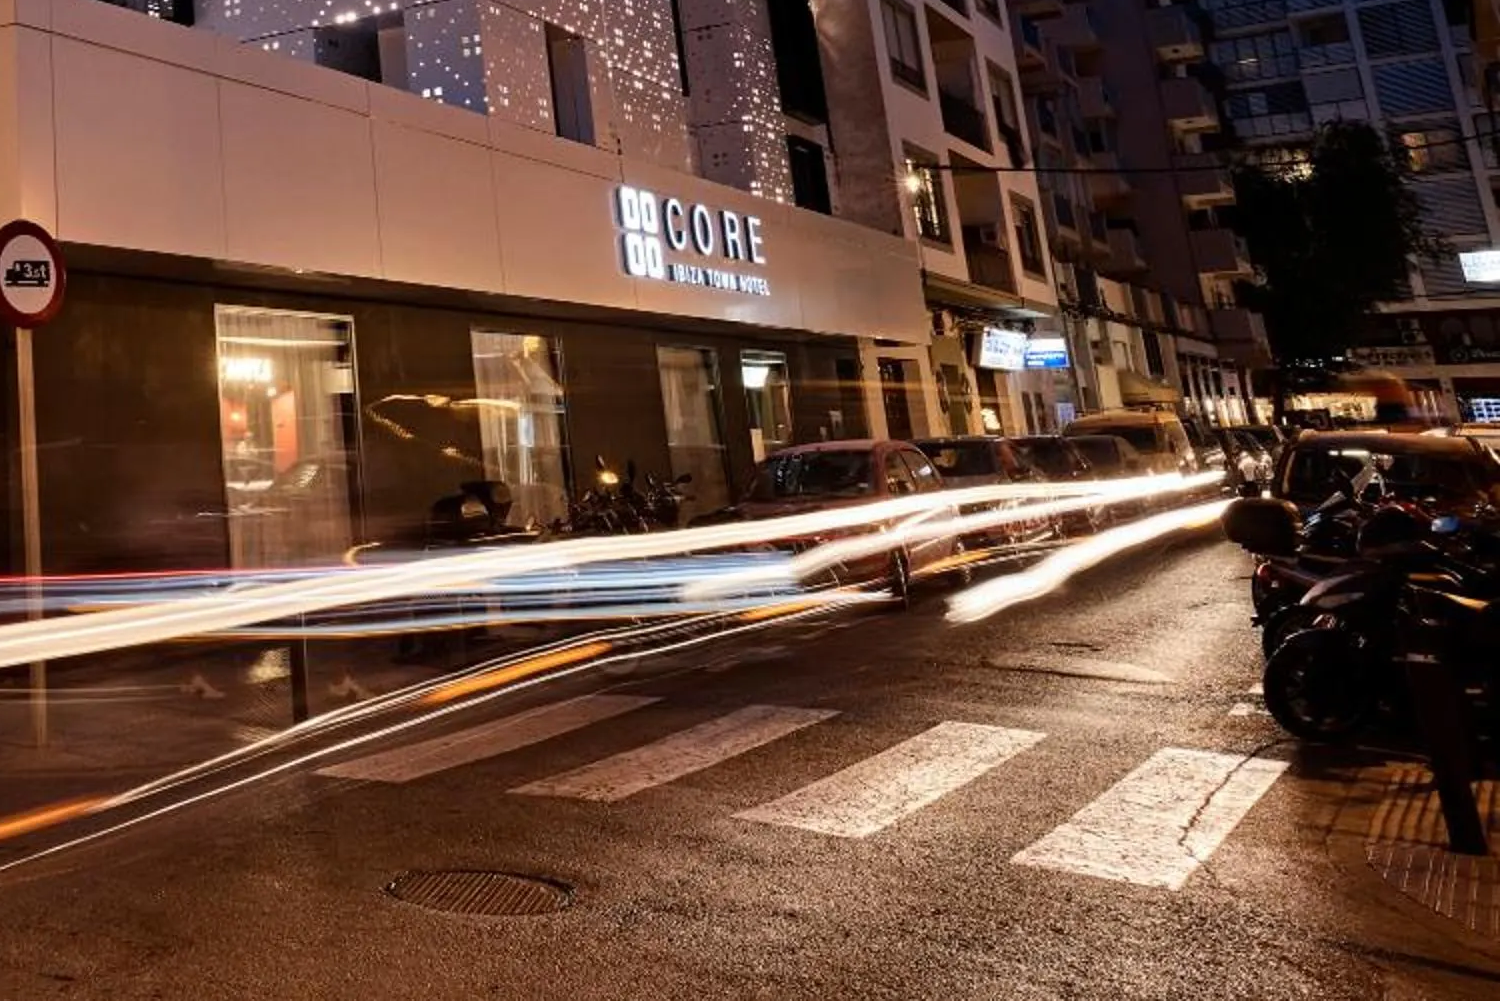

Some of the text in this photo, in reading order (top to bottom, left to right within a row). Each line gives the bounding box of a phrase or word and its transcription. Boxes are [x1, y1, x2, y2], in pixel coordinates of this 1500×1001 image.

[665, 198, 767, 265] CORE
[672, 263, 771, 296] IBIZA TOWN HOTEL
